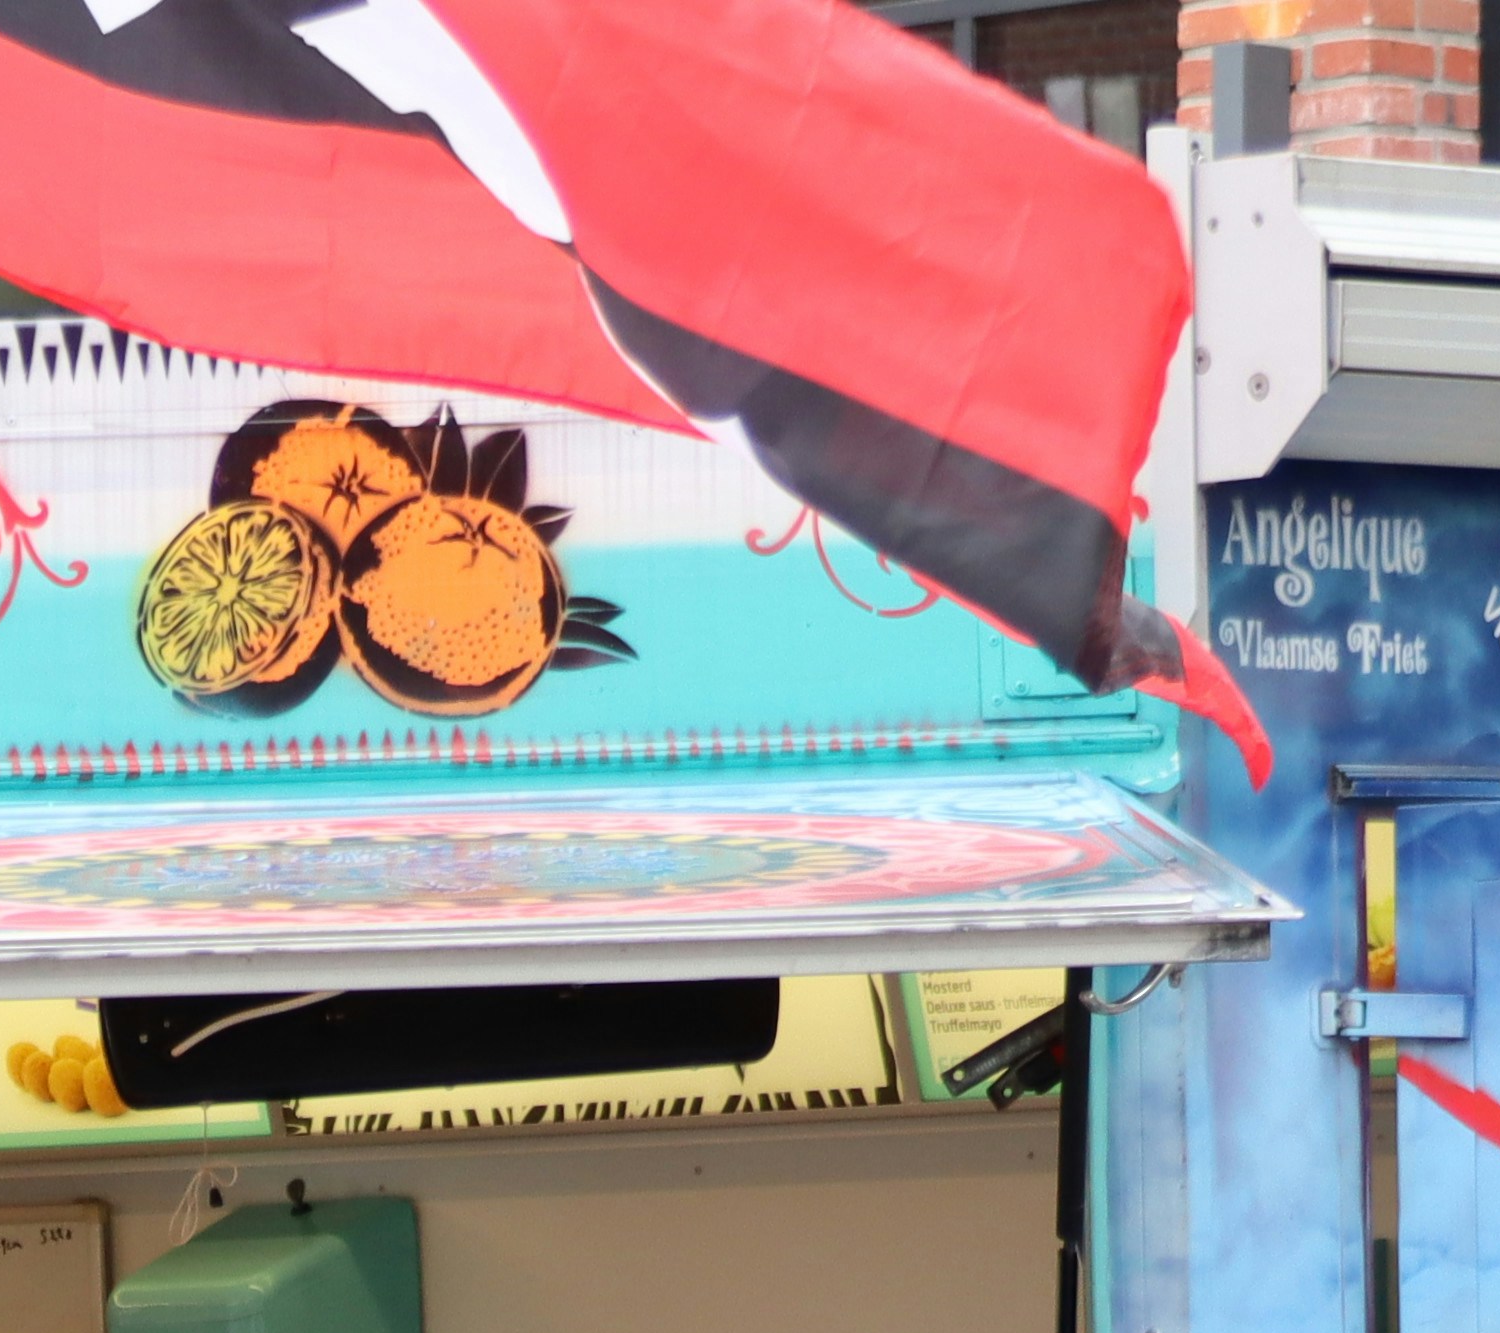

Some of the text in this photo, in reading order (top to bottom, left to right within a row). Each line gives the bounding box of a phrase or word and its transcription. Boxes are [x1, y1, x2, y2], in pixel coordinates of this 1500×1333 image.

[1221, 497, 1426, 607] Angelique
[1219, 618, 1429, 676] Vlaamse Friet
[922, 979, 973, 996] Mosterd
[929, 1017, 1002, 1034] Truffelmayo
